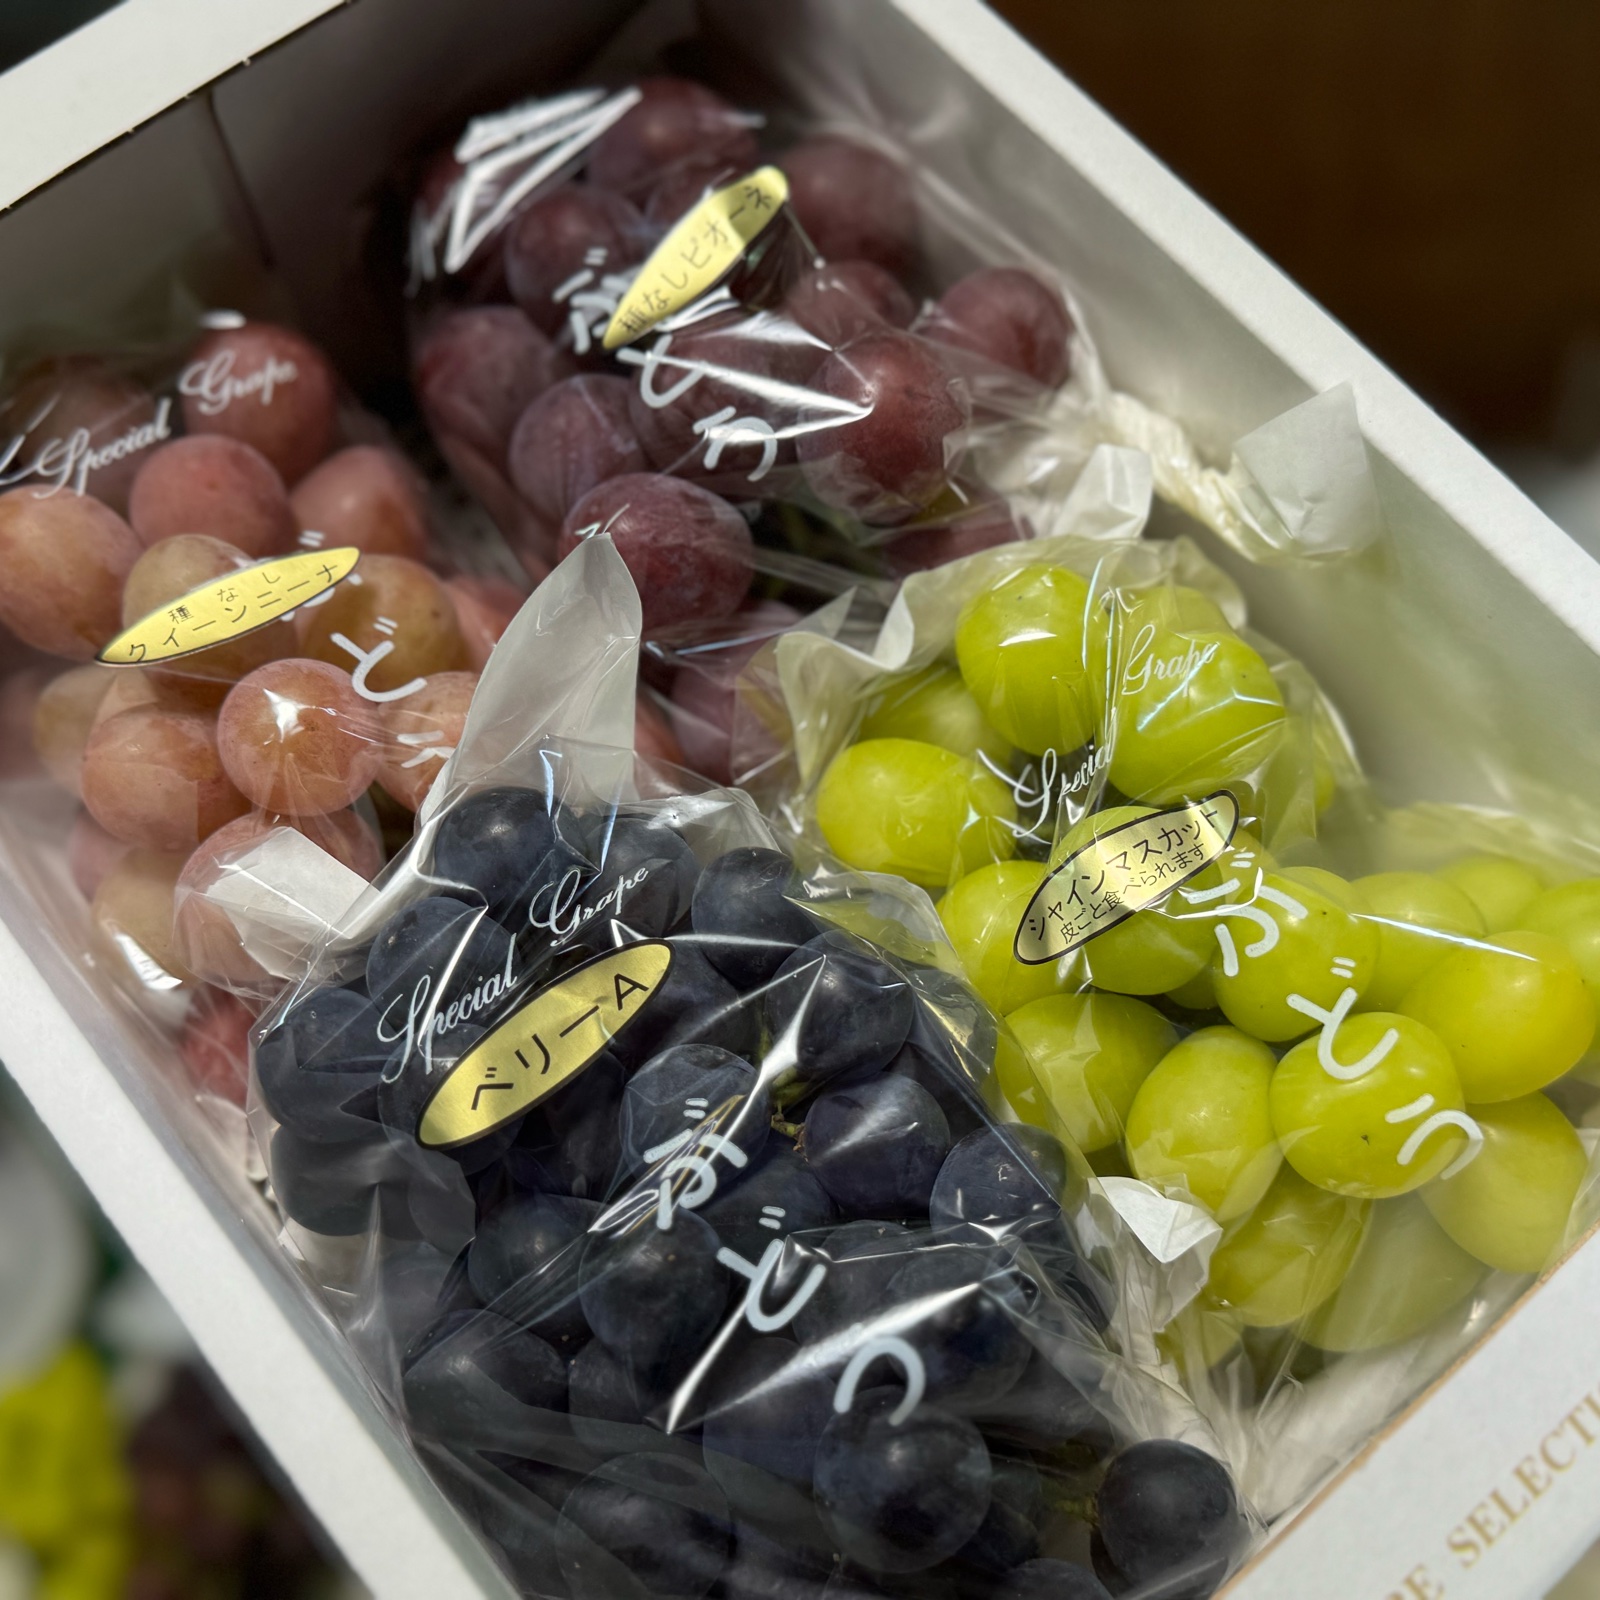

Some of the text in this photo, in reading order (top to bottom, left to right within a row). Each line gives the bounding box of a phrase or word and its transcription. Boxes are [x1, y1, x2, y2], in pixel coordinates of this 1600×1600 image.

[617, 183, 772, 334] 種なしピオーネ
[31, 350, 298, 499] Special Grape
[128, 563, 338, 662] クイーンニーナ
[168, 571, 281, 624] 種なし
[1012, 624, 1220, 838] Special Grape
[1028, 808, 1219, 941] シャインマスカット
[1060, 842, 1205, 945] 皮ごと食べられます
[376, 867, 650, 1084] Special Grape
[470, 972, 651, 1112] ベリーA
[1186, 852, 1484, 1180] ぶどう
